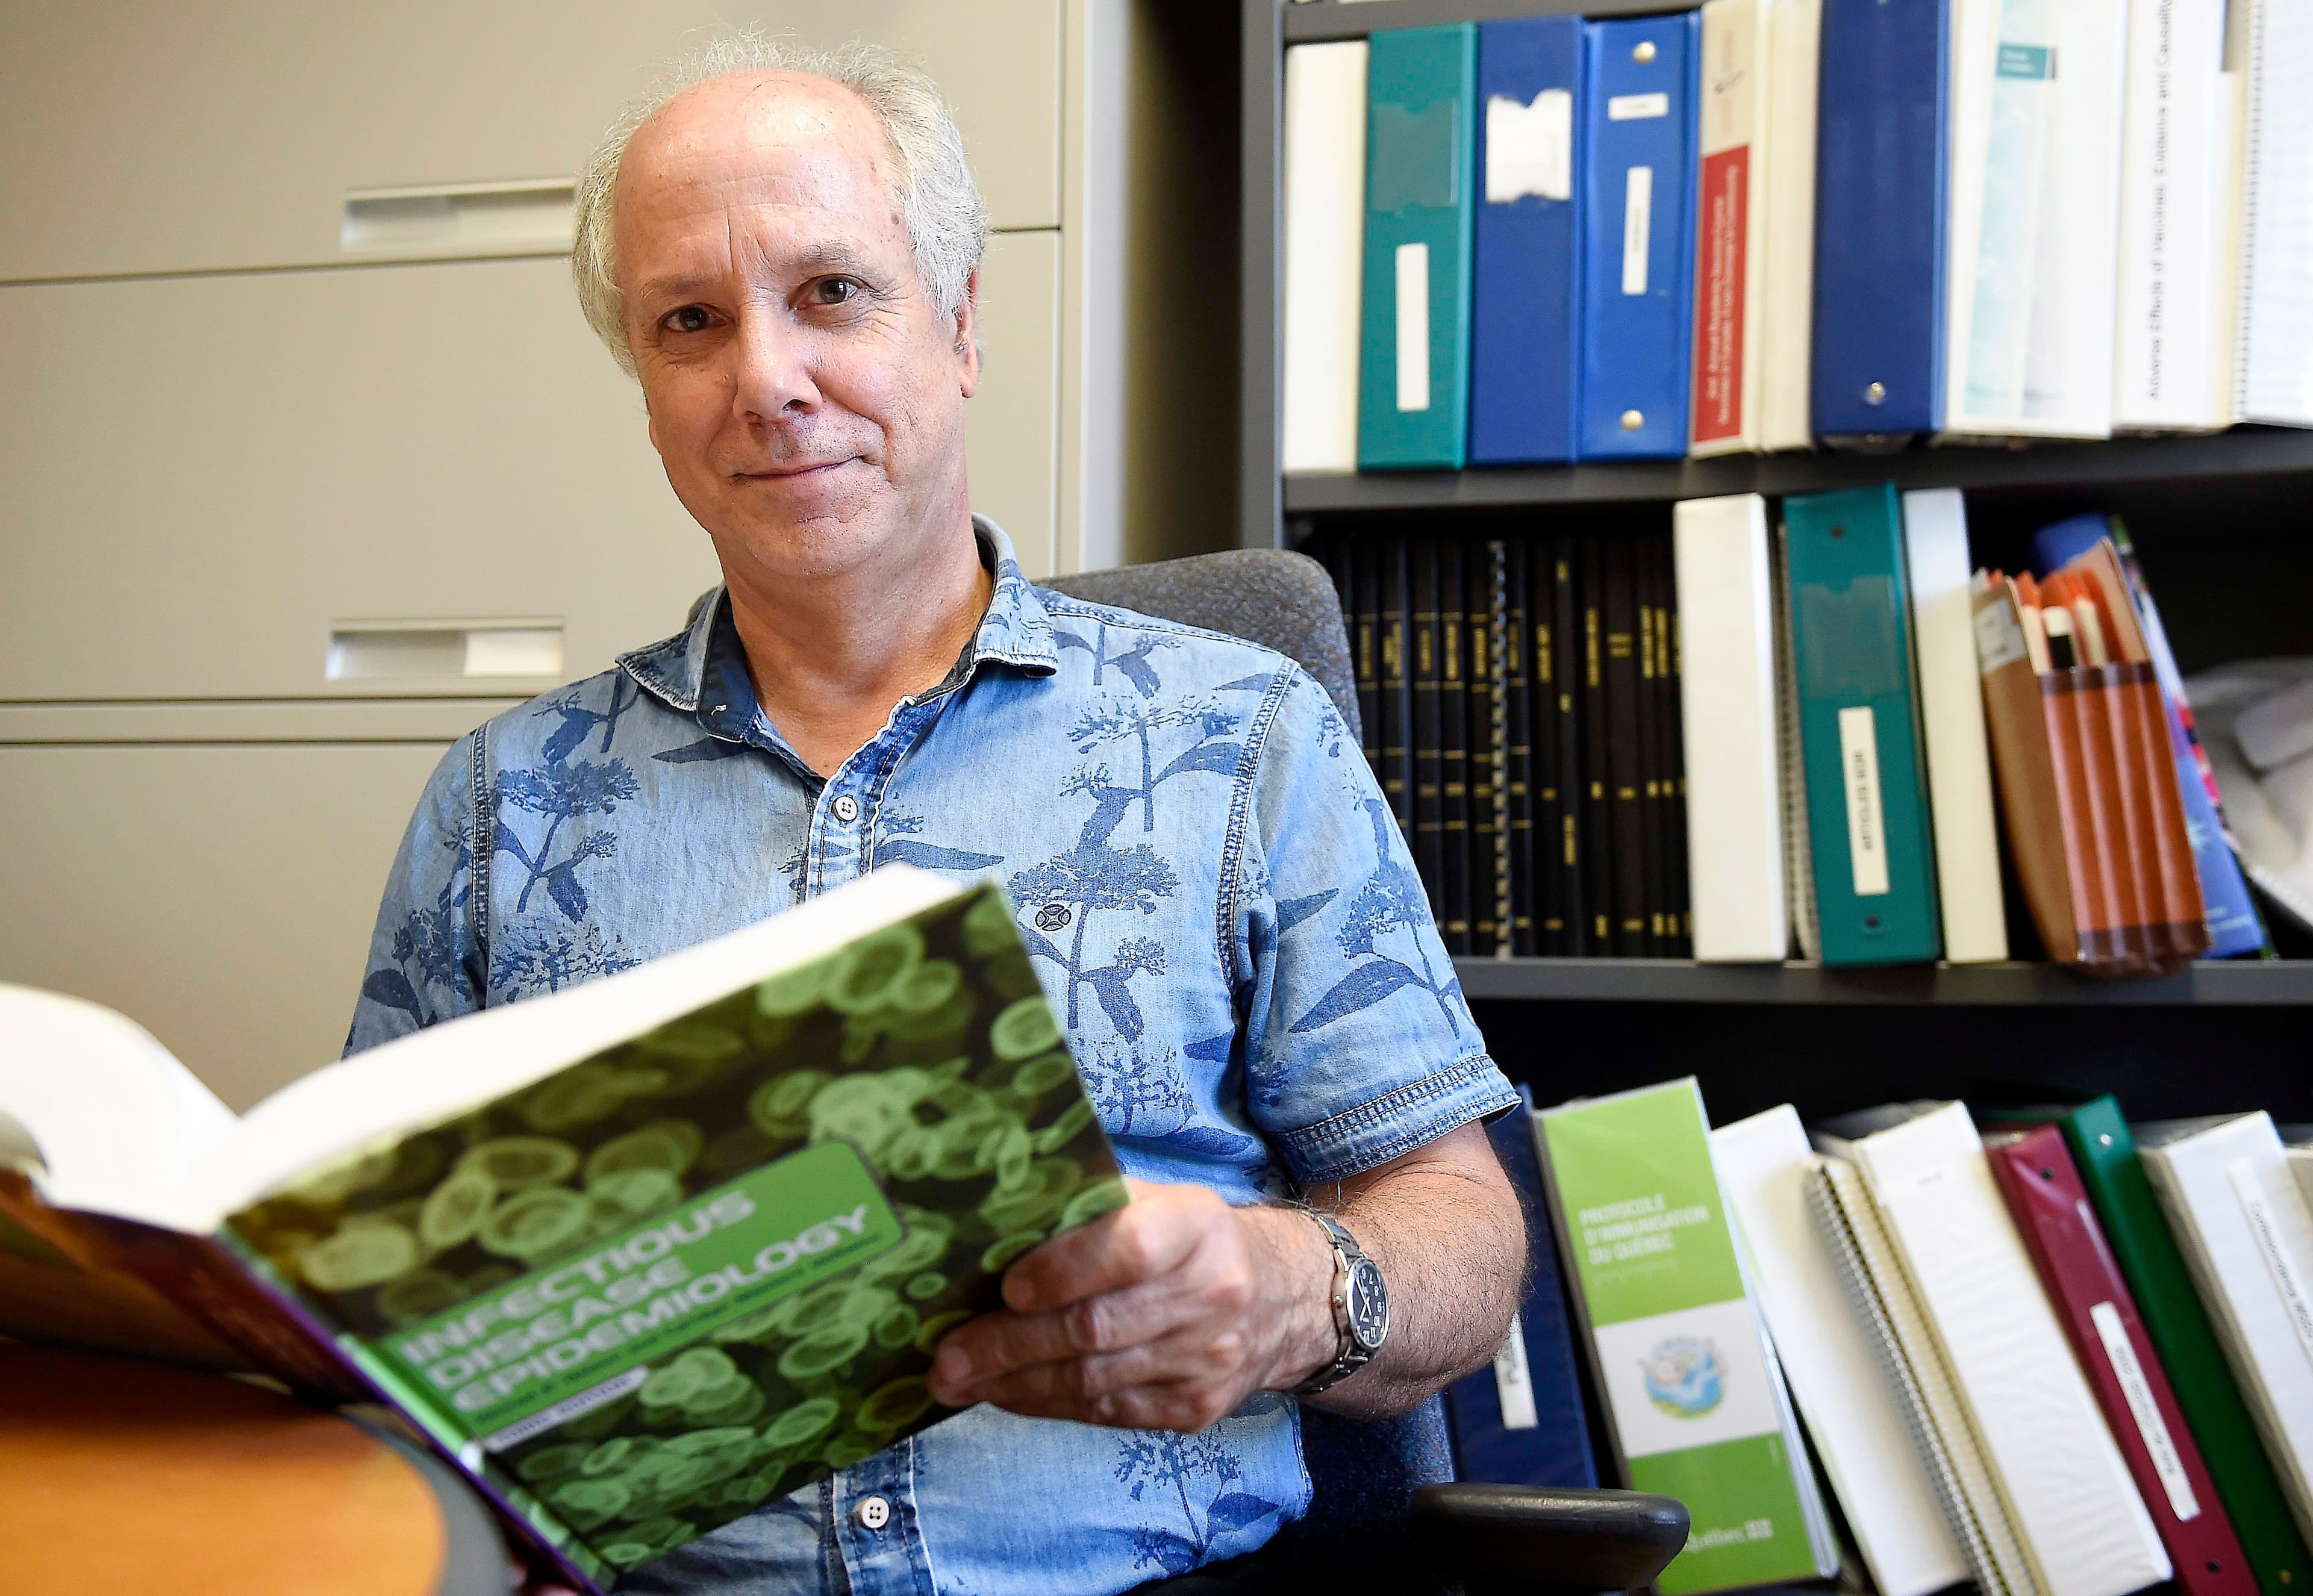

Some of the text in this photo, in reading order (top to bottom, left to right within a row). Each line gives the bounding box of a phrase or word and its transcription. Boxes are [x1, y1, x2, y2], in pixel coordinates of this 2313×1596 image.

[402, 1189, 757, 1365] INFECTIOUS
[1579, 1192, 1665, 1227] PROTOCOLE
[1588, 1247, 1612, 1265] DU
[425, 1255, 691, 1391] DISEASE
[452, 1205, 869, 1412] EPIDEMIOLOGY
